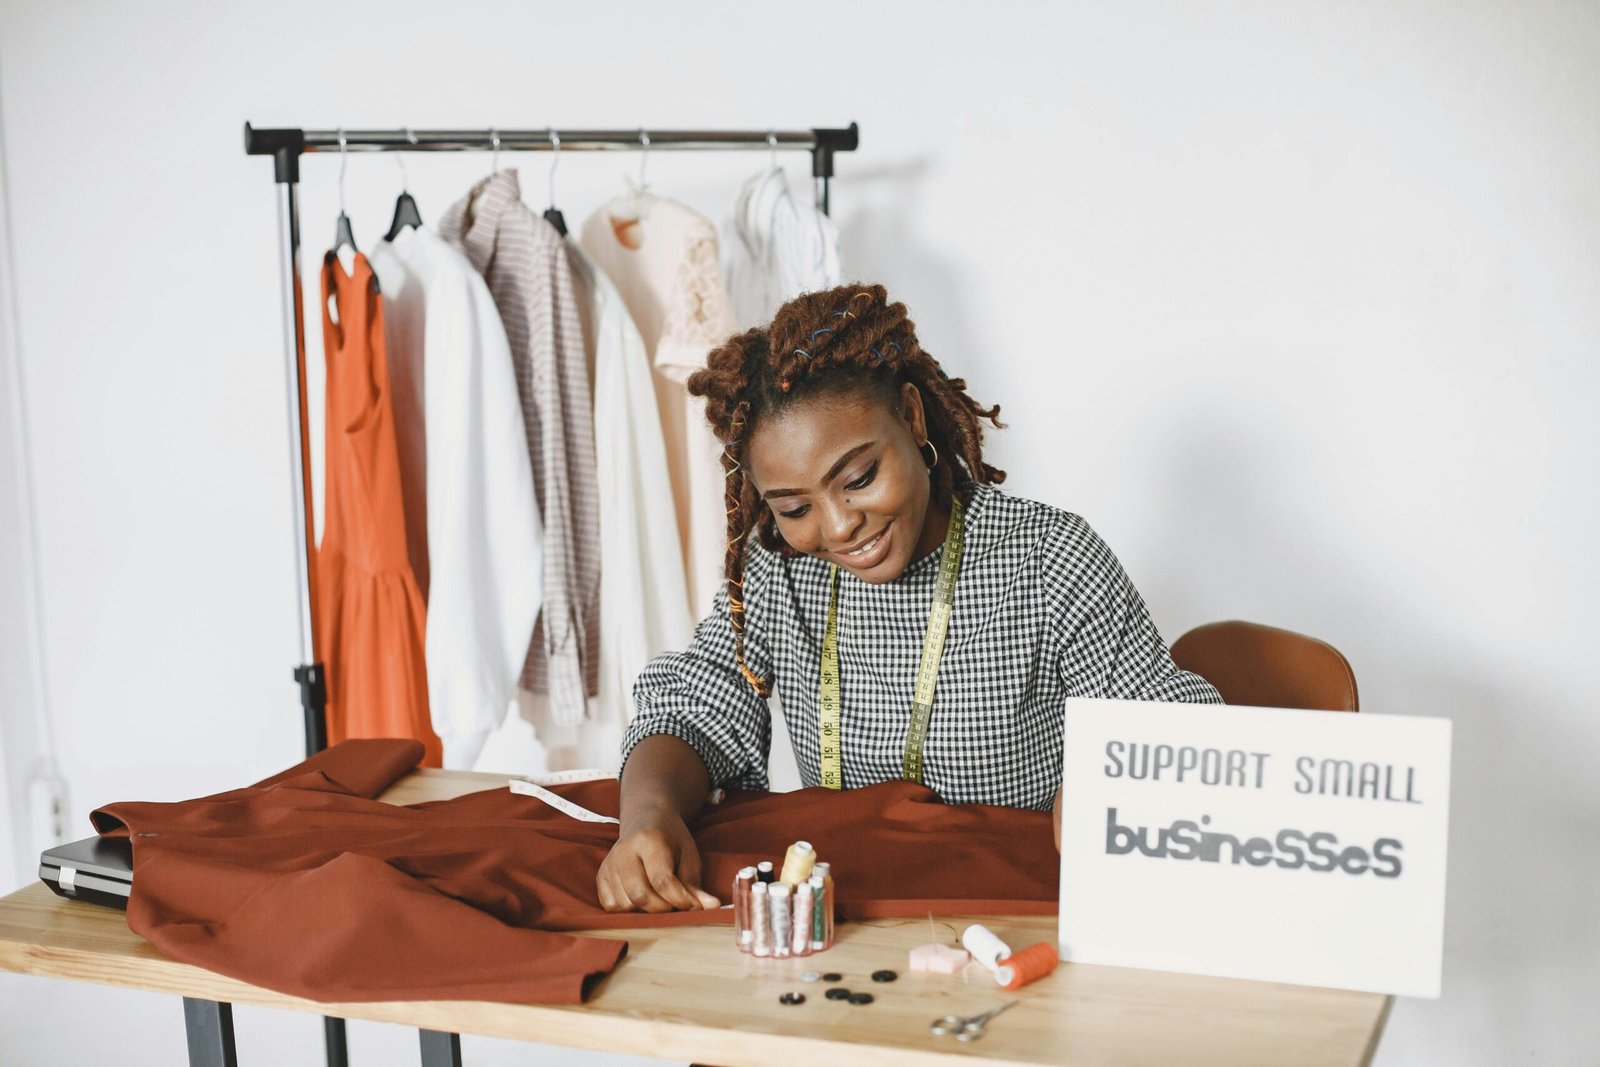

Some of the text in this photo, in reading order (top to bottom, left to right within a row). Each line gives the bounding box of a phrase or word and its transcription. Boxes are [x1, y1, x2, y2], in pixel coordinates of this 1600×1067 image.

[824, 722, 833, 736] 50
[1104, 741, 1421, 803] SUPPORT SMALL
